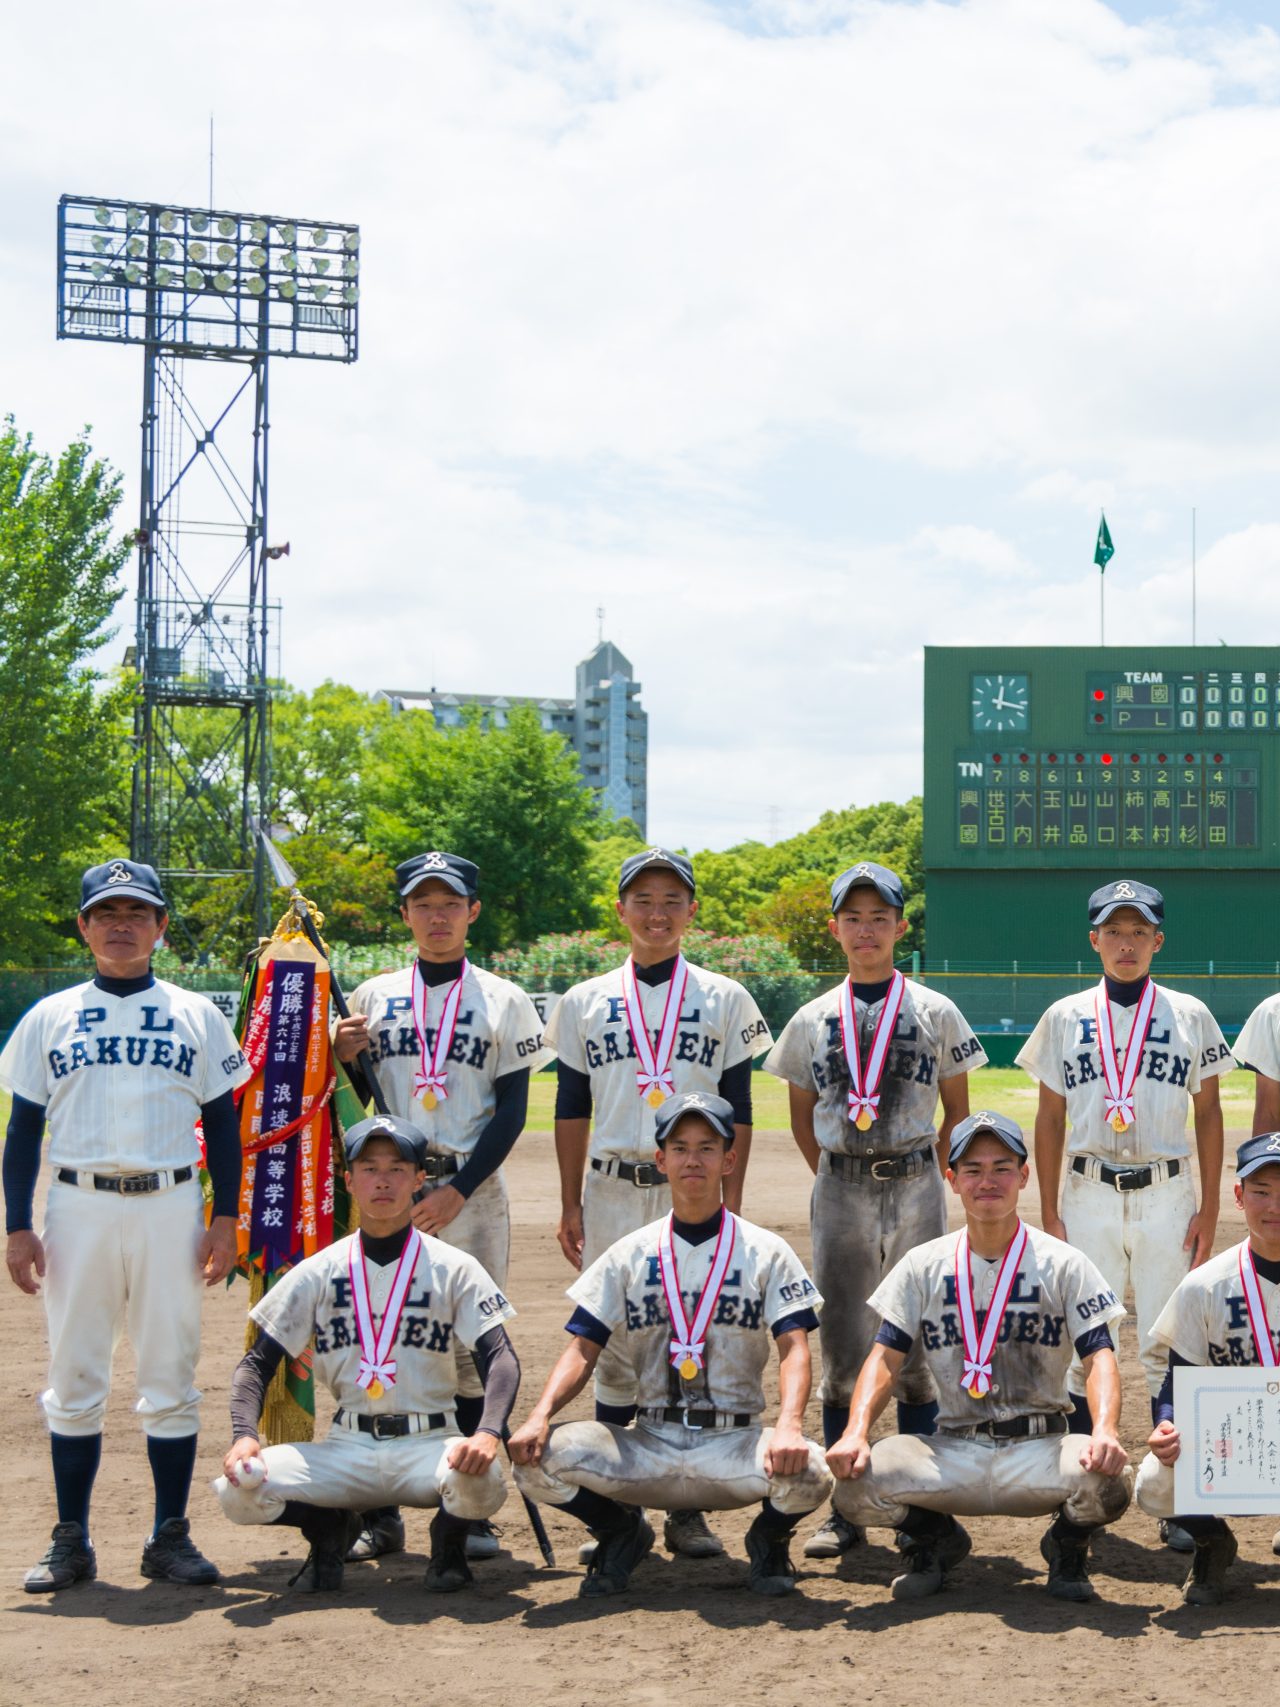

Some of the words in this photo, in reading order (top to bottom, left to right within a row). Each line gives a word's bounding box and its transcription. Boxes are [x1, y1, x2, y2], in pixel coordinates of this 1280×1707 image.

[1124, 672, 1163, 683] TEAM
[1182, 687, 1194, 704] 0
[1207, 687, 1219, 704] 0
[1231, 687, 1243, 704] 0
[1254, 687, 1266, 704] 0
[1182, 711, 1194, 727] 0
[1207, 711, 1219, 727] 0
[1231, 711, 1243, 727] 0
[1254, 711, 1266, 727] 0
[958, 762, 983, 777] TN
[992, 770, 1002, 783] 7
[1019, 770, 1029, 783] 8
[1048, 770, 1057, 783] 6
[1077, 770, 1083, 783] 1
[1102, 770, 1112, 783] 9
[1131, 770, 1141, 783] 3
[1157, 770, 1168, 783] 2
[1184, 770, 1194, 783] 5
[1213, 770, 1223, 783] 4
[279, 972, 305, 1013] 優勝
[274, 1015, 289, 1061] 第六十回
[49, 1037, 197, 1078] GAKUEN
